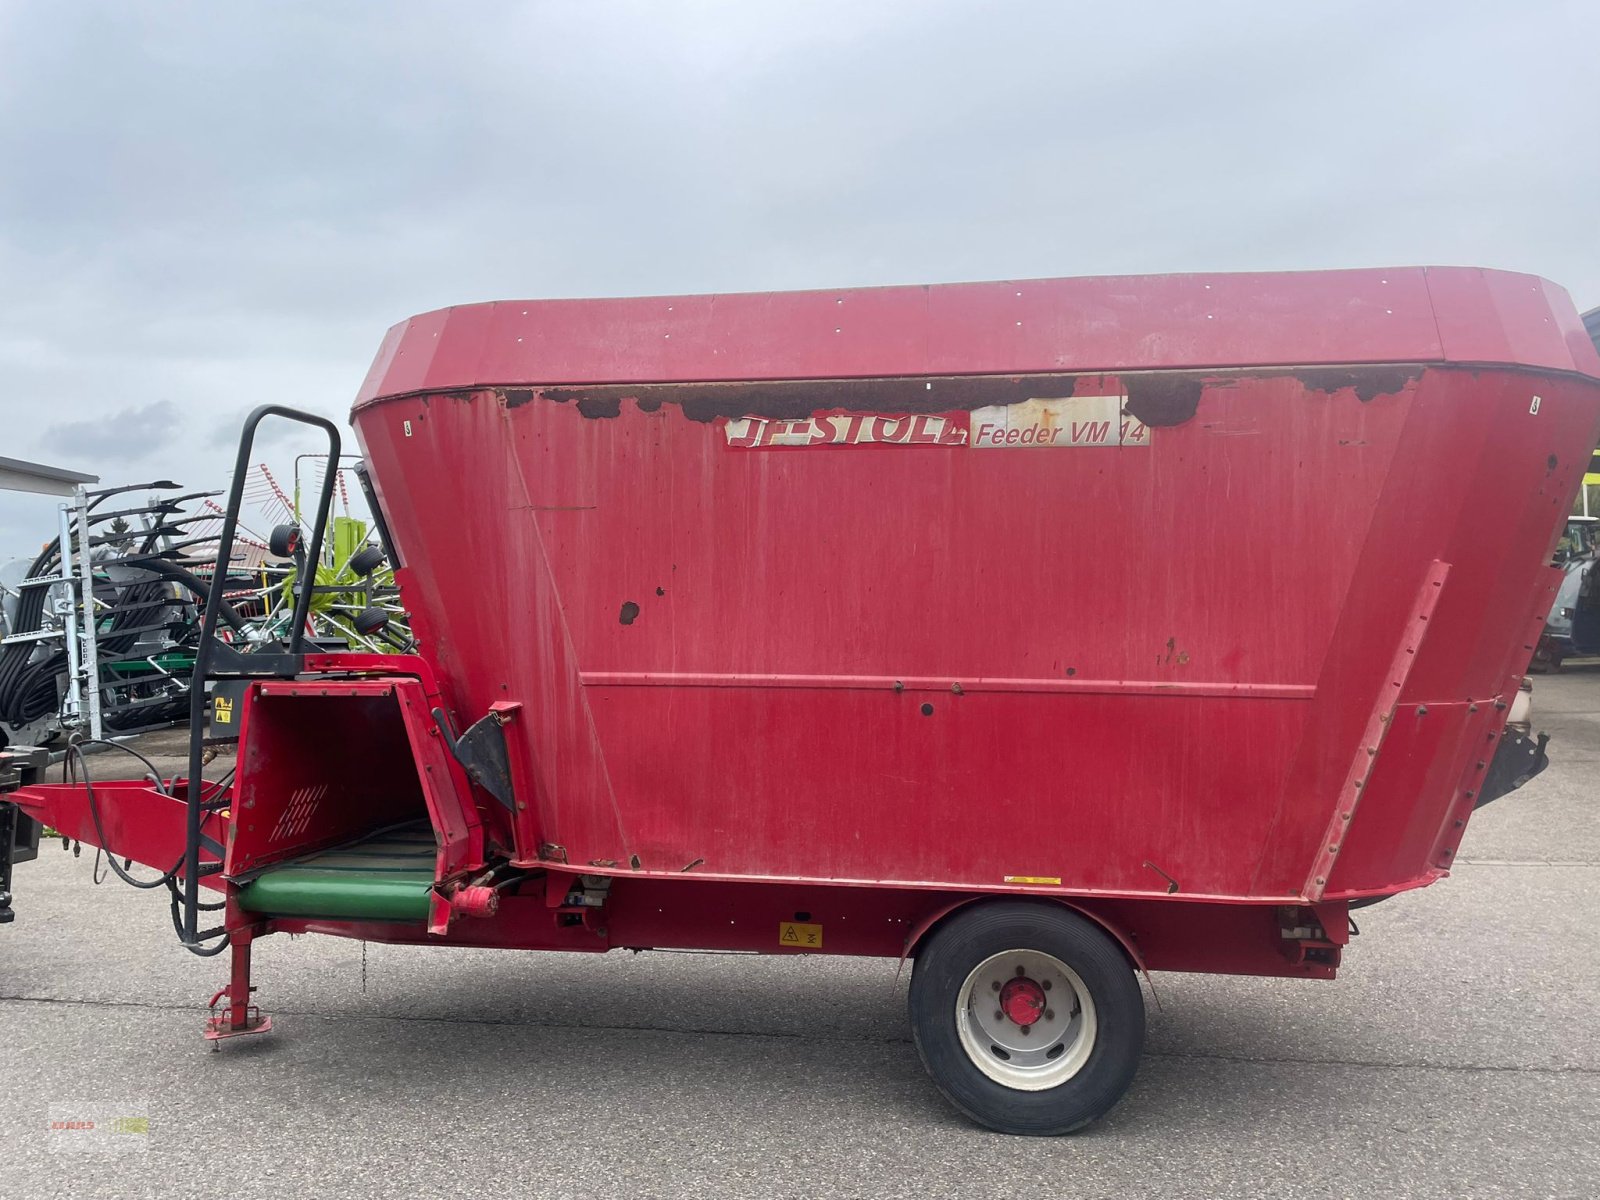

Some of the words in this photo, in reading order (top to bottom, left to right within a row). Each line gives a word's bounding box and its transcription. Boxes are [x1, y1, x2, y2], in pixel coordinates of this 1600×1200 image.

[974, 421, 1064, 446] Feeder
[1071, 420, 1111, 444] VM
[1121, 420, 1147, 444] 14
